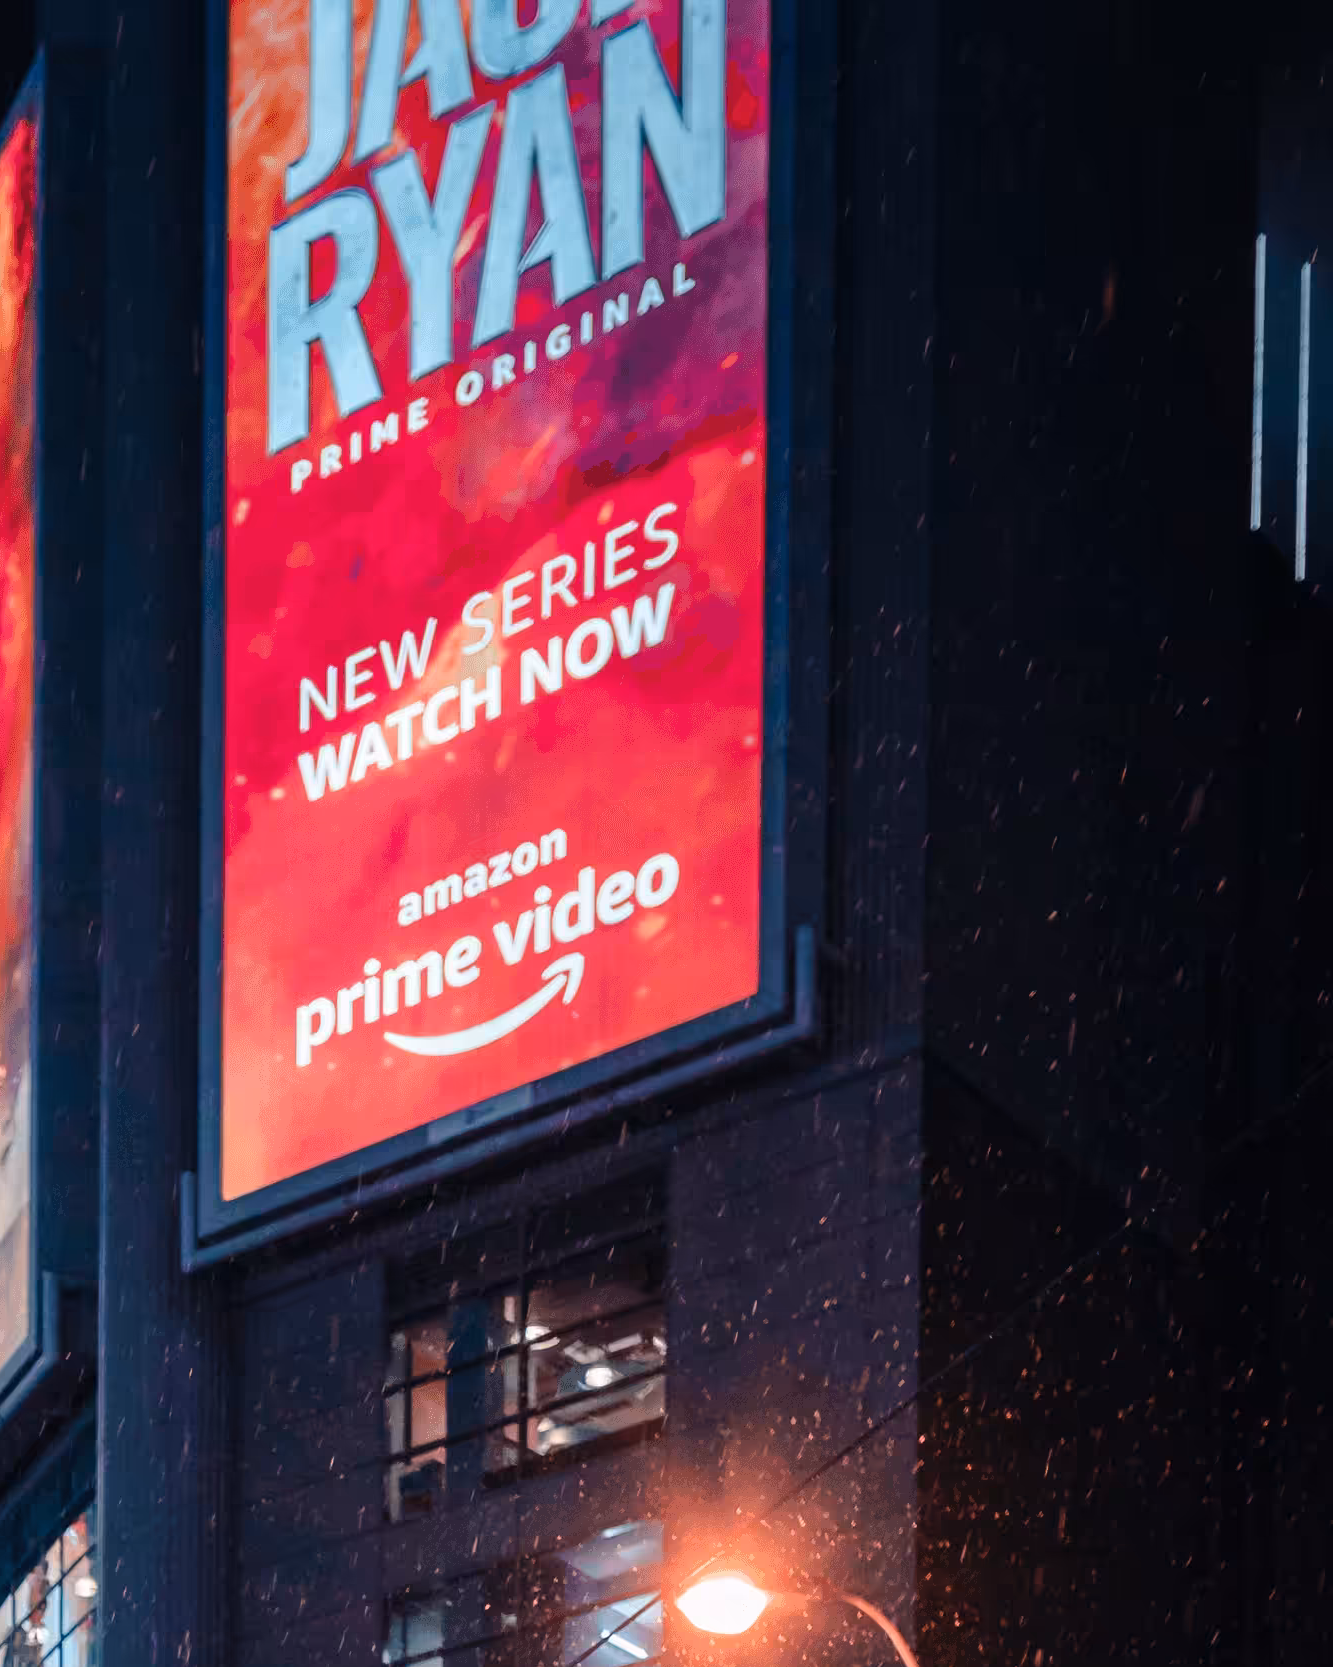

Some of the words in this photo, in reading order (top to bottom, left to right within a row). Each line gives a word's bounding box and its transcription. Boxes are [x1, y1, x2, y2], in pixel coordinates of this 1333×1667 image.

[269, 0, 726, 457] RYAN
[290, 399, 429, 494] PRIME
[455, 262, 696, 406] ORIGINAL
[297, 679, 501, 801] WATCH
[519, 583, 675, 704] NOW
[299, 617, 437, 733] NEW
[461, 502, 680, 655] SERIES
[295, 934, 481, 1067] prime
[493, 853, 680, 966] video
[397, 828, 567, 927] amazon
